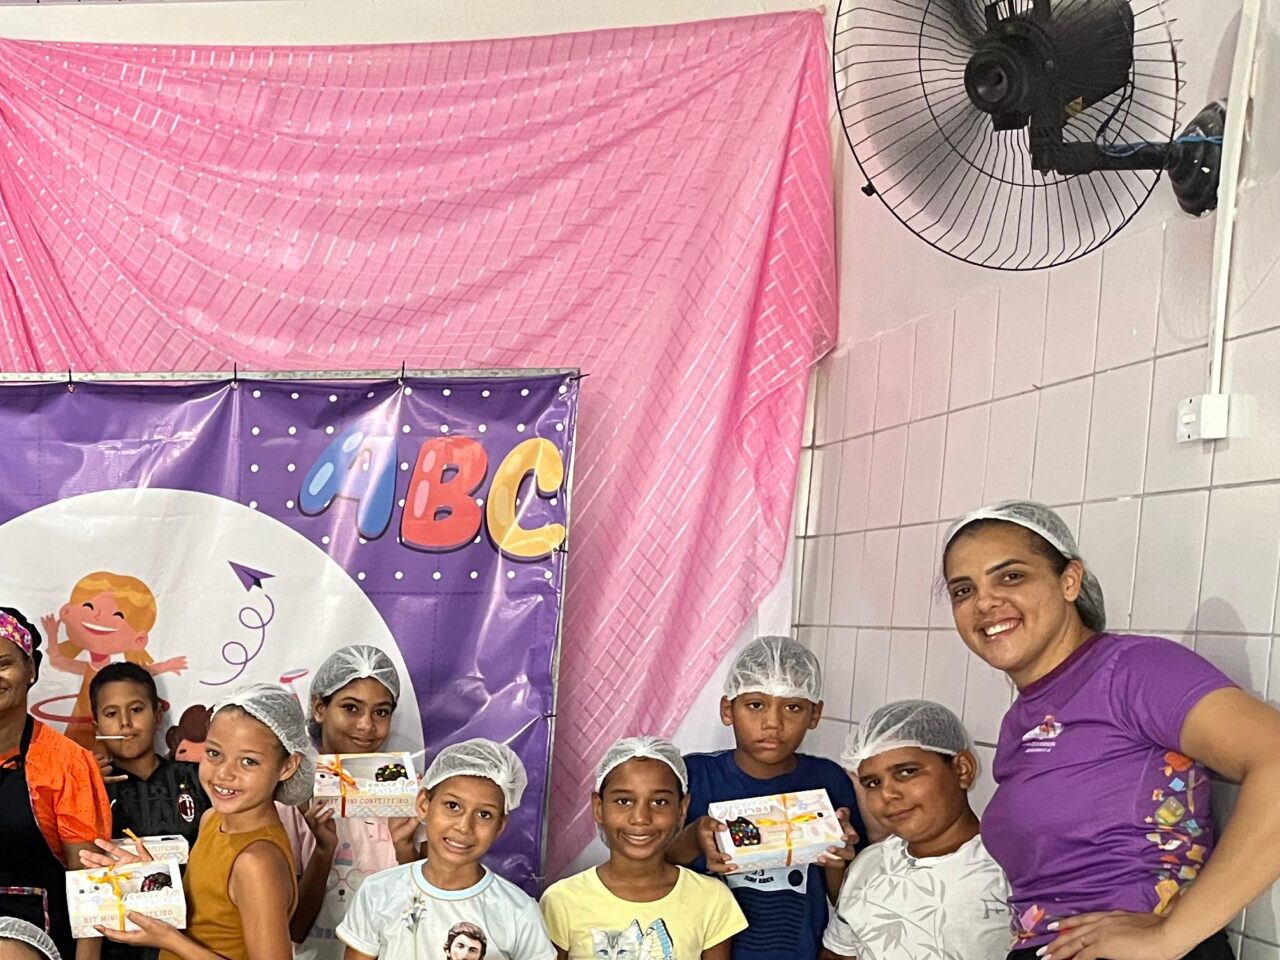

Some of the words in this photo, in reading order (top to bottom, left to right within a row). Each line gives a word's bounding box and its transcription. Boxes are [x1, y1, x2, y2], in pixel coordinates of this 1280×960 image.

[298, 421, 566, 562] ABC
[83, 916, 98, 925] KIT
[100, 914, 118, 923] MINI
